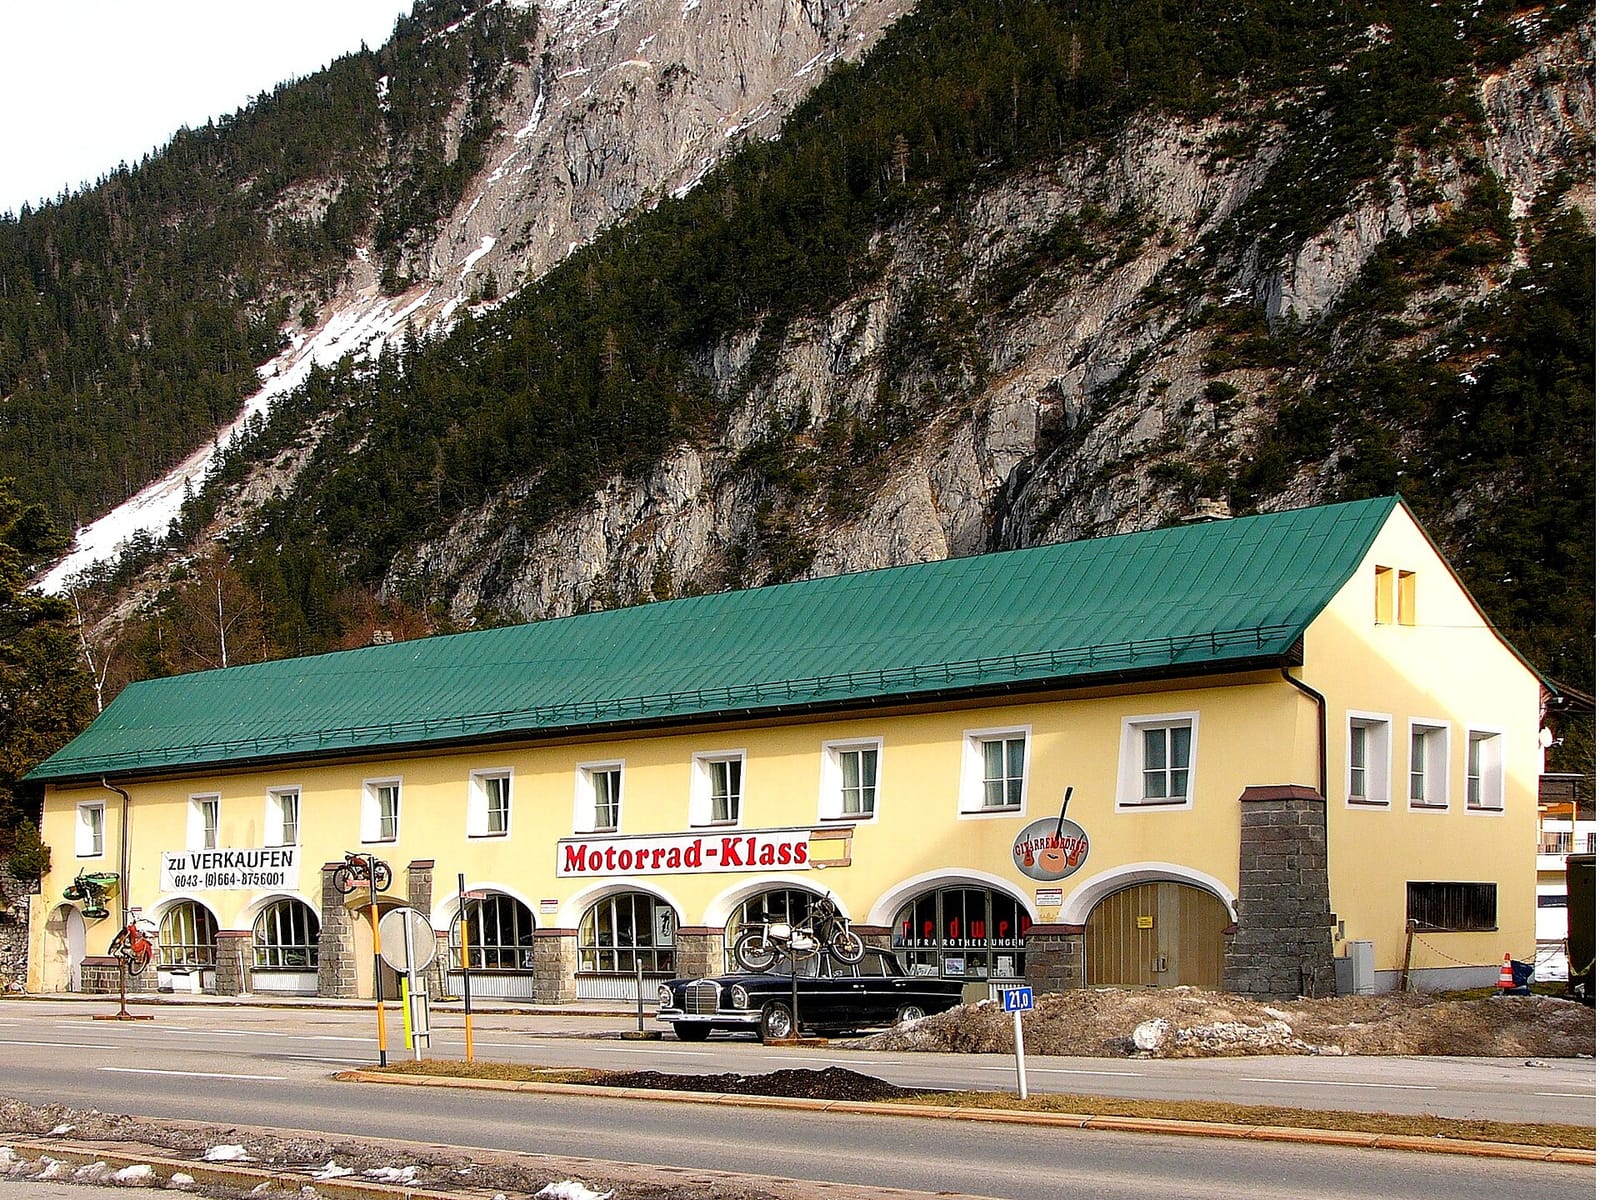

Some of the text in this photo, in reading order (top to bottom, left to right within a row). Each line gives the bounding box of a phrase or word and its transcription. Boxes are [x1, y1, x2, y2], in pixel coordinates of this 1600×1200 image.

[191, 850, 293, 870] VERKAUFEN
[564, 837, 808, 872] Motorrad-Klass
[902, 938, 1025, 947] INFRAROTHEIZUNGEN
[1009, 990, 1029, 1009] 21,0
